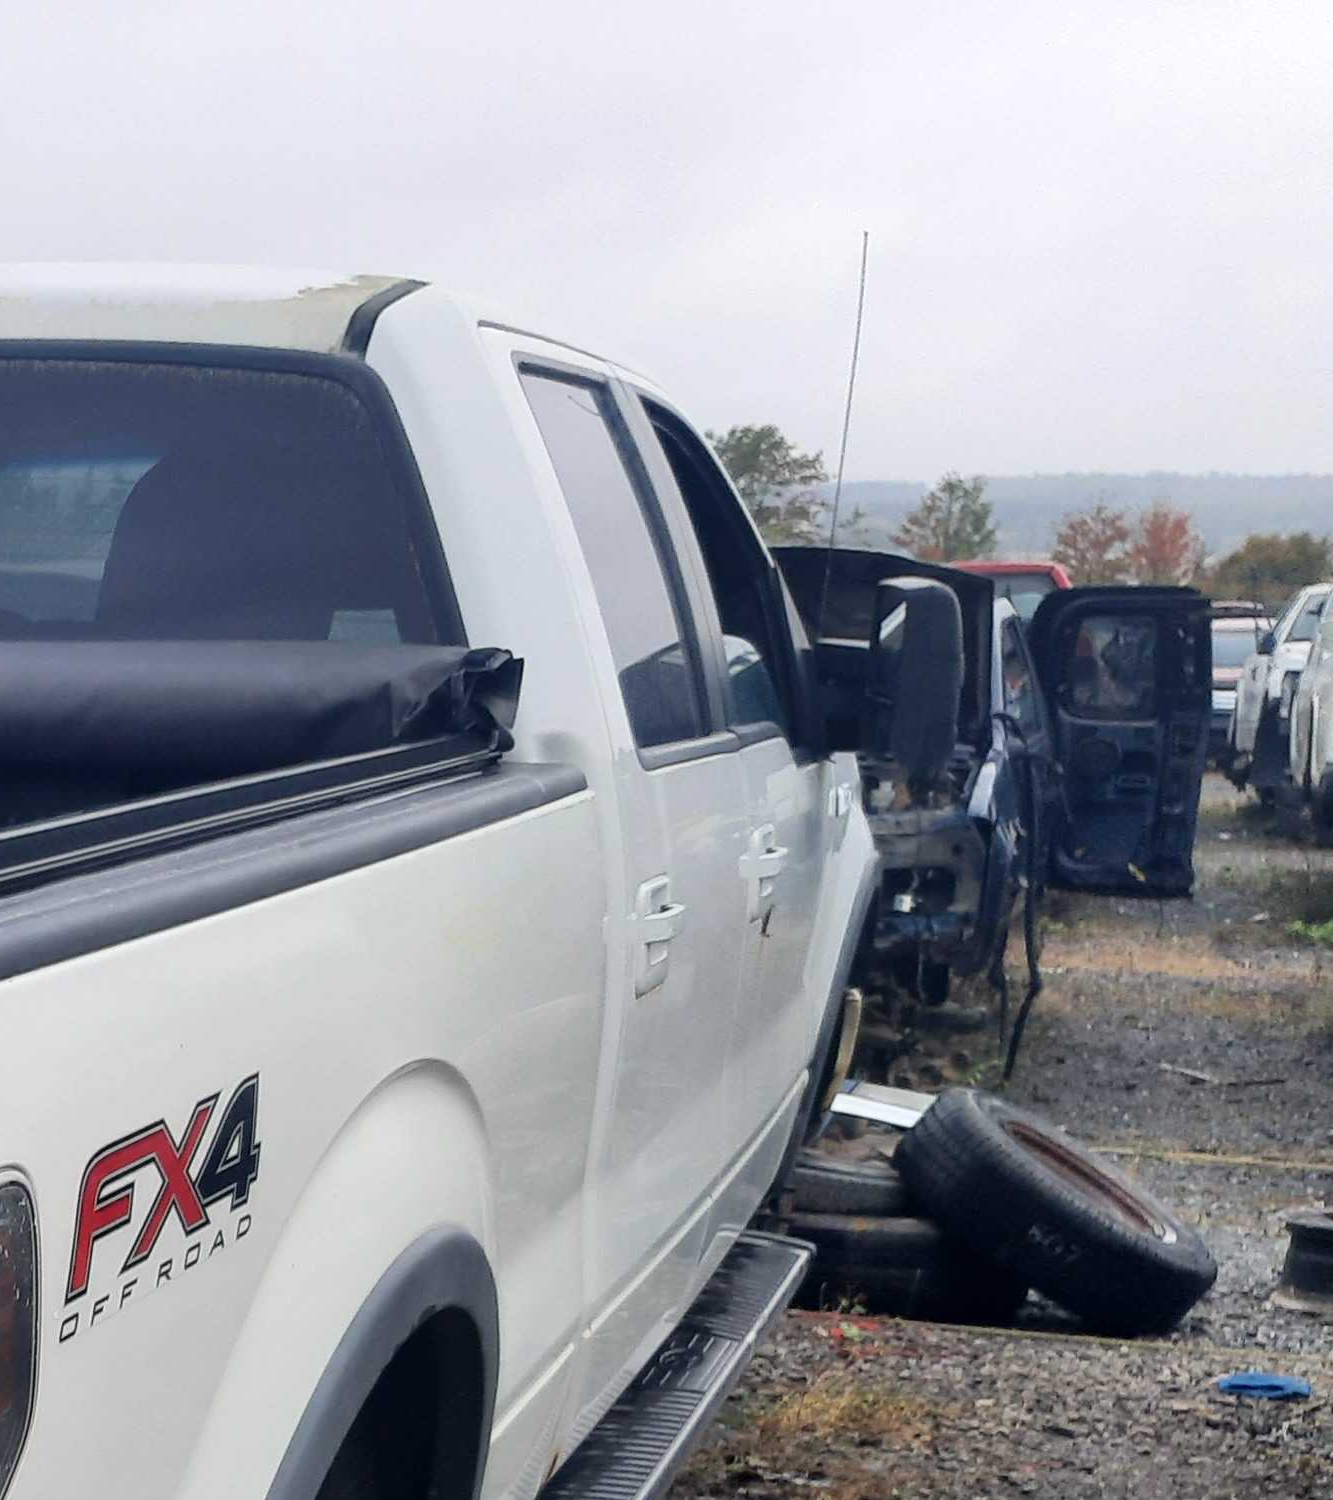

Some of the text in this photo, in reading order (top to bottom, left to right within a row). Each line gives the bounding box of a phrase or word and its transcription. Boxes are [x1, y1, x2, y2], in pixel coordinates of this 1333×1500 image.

[58, 1213, 252, 1344] OFF ROAD
[64, 1071, 261, 1306] FX4
